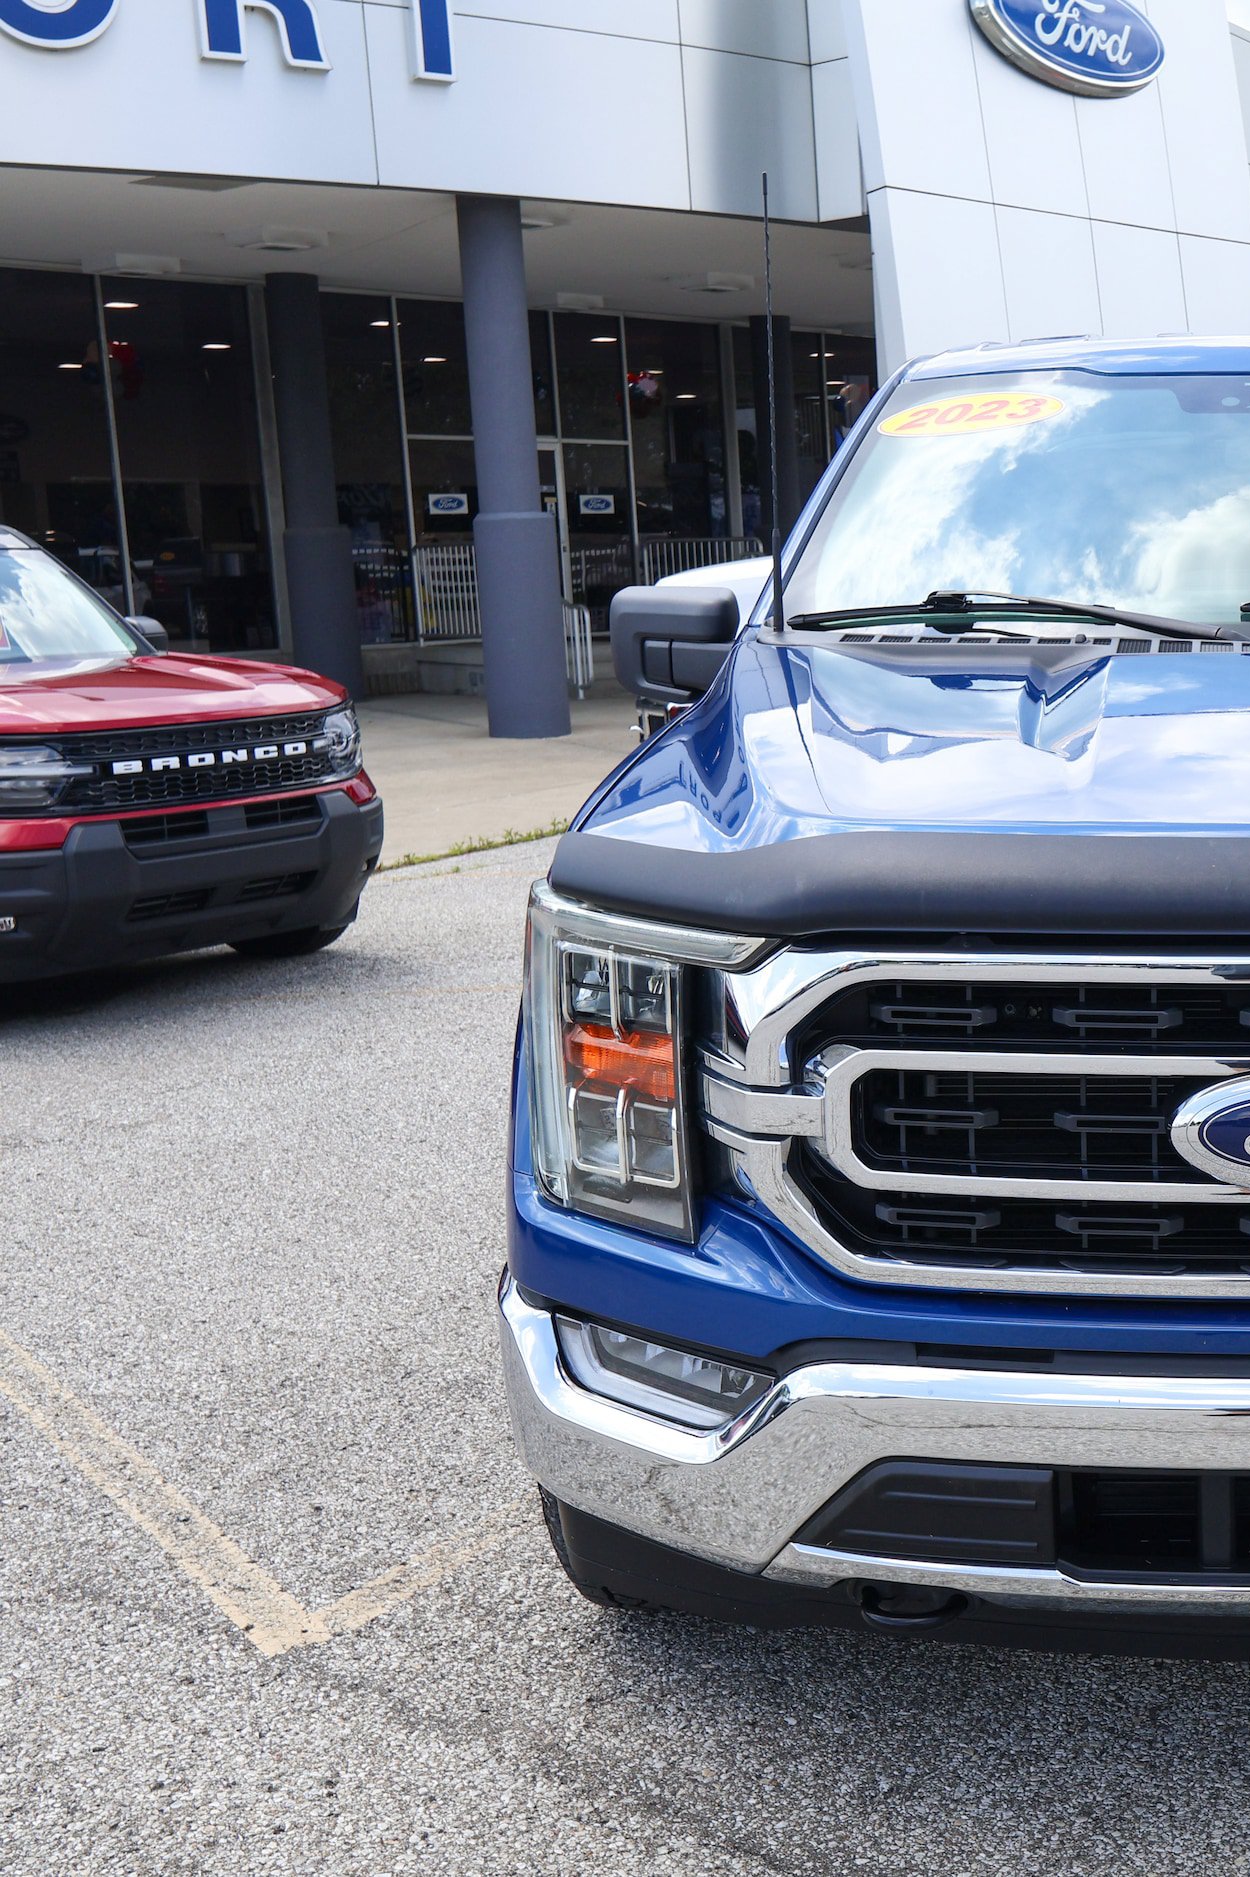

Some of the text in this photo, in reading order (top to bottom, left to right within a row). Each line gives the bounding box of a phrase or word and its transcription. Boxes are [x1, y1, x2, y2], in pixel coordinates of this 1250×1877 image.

[1034, 0, 1132, 66] Ford
[895, 398, 1048, 431] 2023
[438, 497, 460, 509] Ford
[588, 498, 607, 509] Ford
[112, 741, 307, 775] BRONCO
